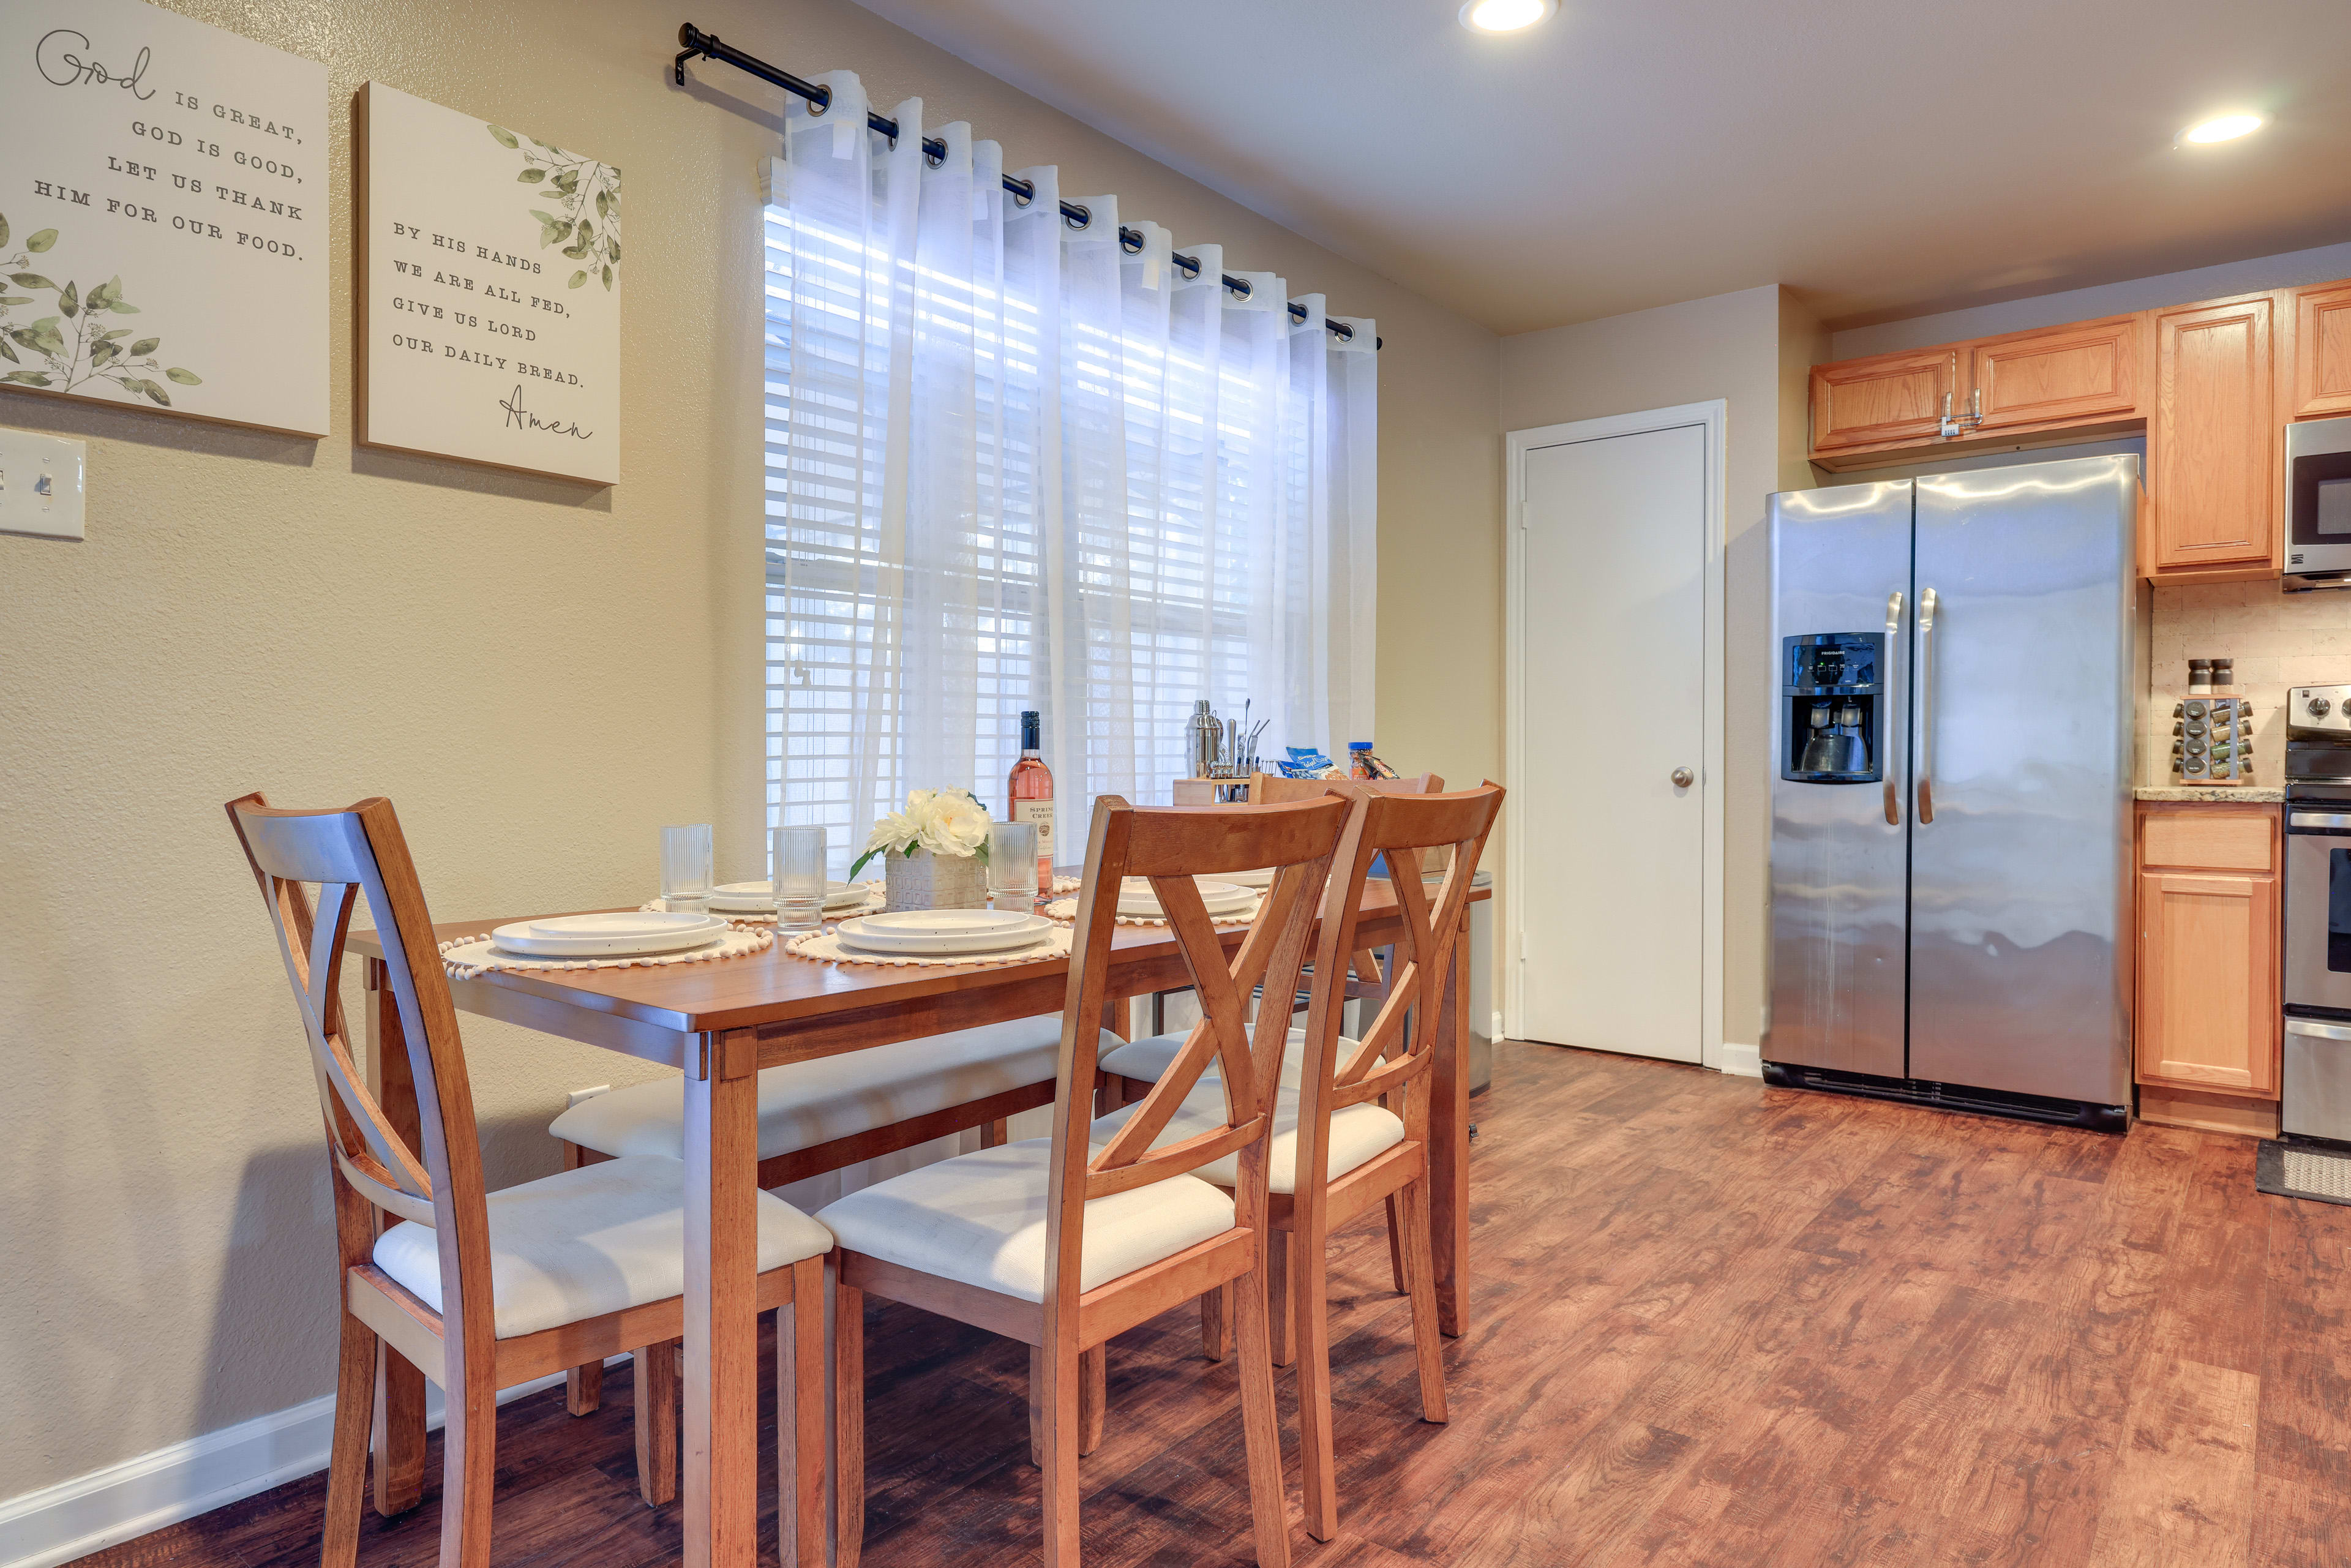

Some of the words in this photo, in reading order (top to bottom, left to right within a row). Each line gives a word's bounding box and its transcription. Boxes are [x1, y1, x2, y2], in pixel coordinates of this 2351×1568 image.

[36, 29, 156, 100] God
[176, 92, 198, 110] IS
[213, 105, 302, 144] GREAT,
[132, 122, 182, 145] GOD
[197, 140, 219, 157] IS
[234, 151, 302, 184] GOOD,
[108, 156, 157, 181] LET
[172, 174, 201, 193] US
[216, 186, 302, 220] THANK
[34, 180, 90, 206] HIM
[107, 198, 157, 222] FOR
[172, 216, 222, 239] OUR
[237, 231, 302, 260] FOOD.
[394, 222, 420, 239] BY
[432, 234, 465, 252] HIS
[476, 246, 541, 274] HANDS
[394, 260, 421, 277] WE
[433, 271, 473, 290] ARE
[484, 285, 520, 303] ALL
[531, 296, 569, 318] FED,
[394, 298, 443, 319] GIVE
[454, 312, 477, 327] US
[488, 320, 535, 340] LORD
[393, 334, 433, 353] OUR
[445, 346, 507, 369] DAILY
[518, 362, 583, 388] BREAD.
[500, 384, 593, 439] Amen
